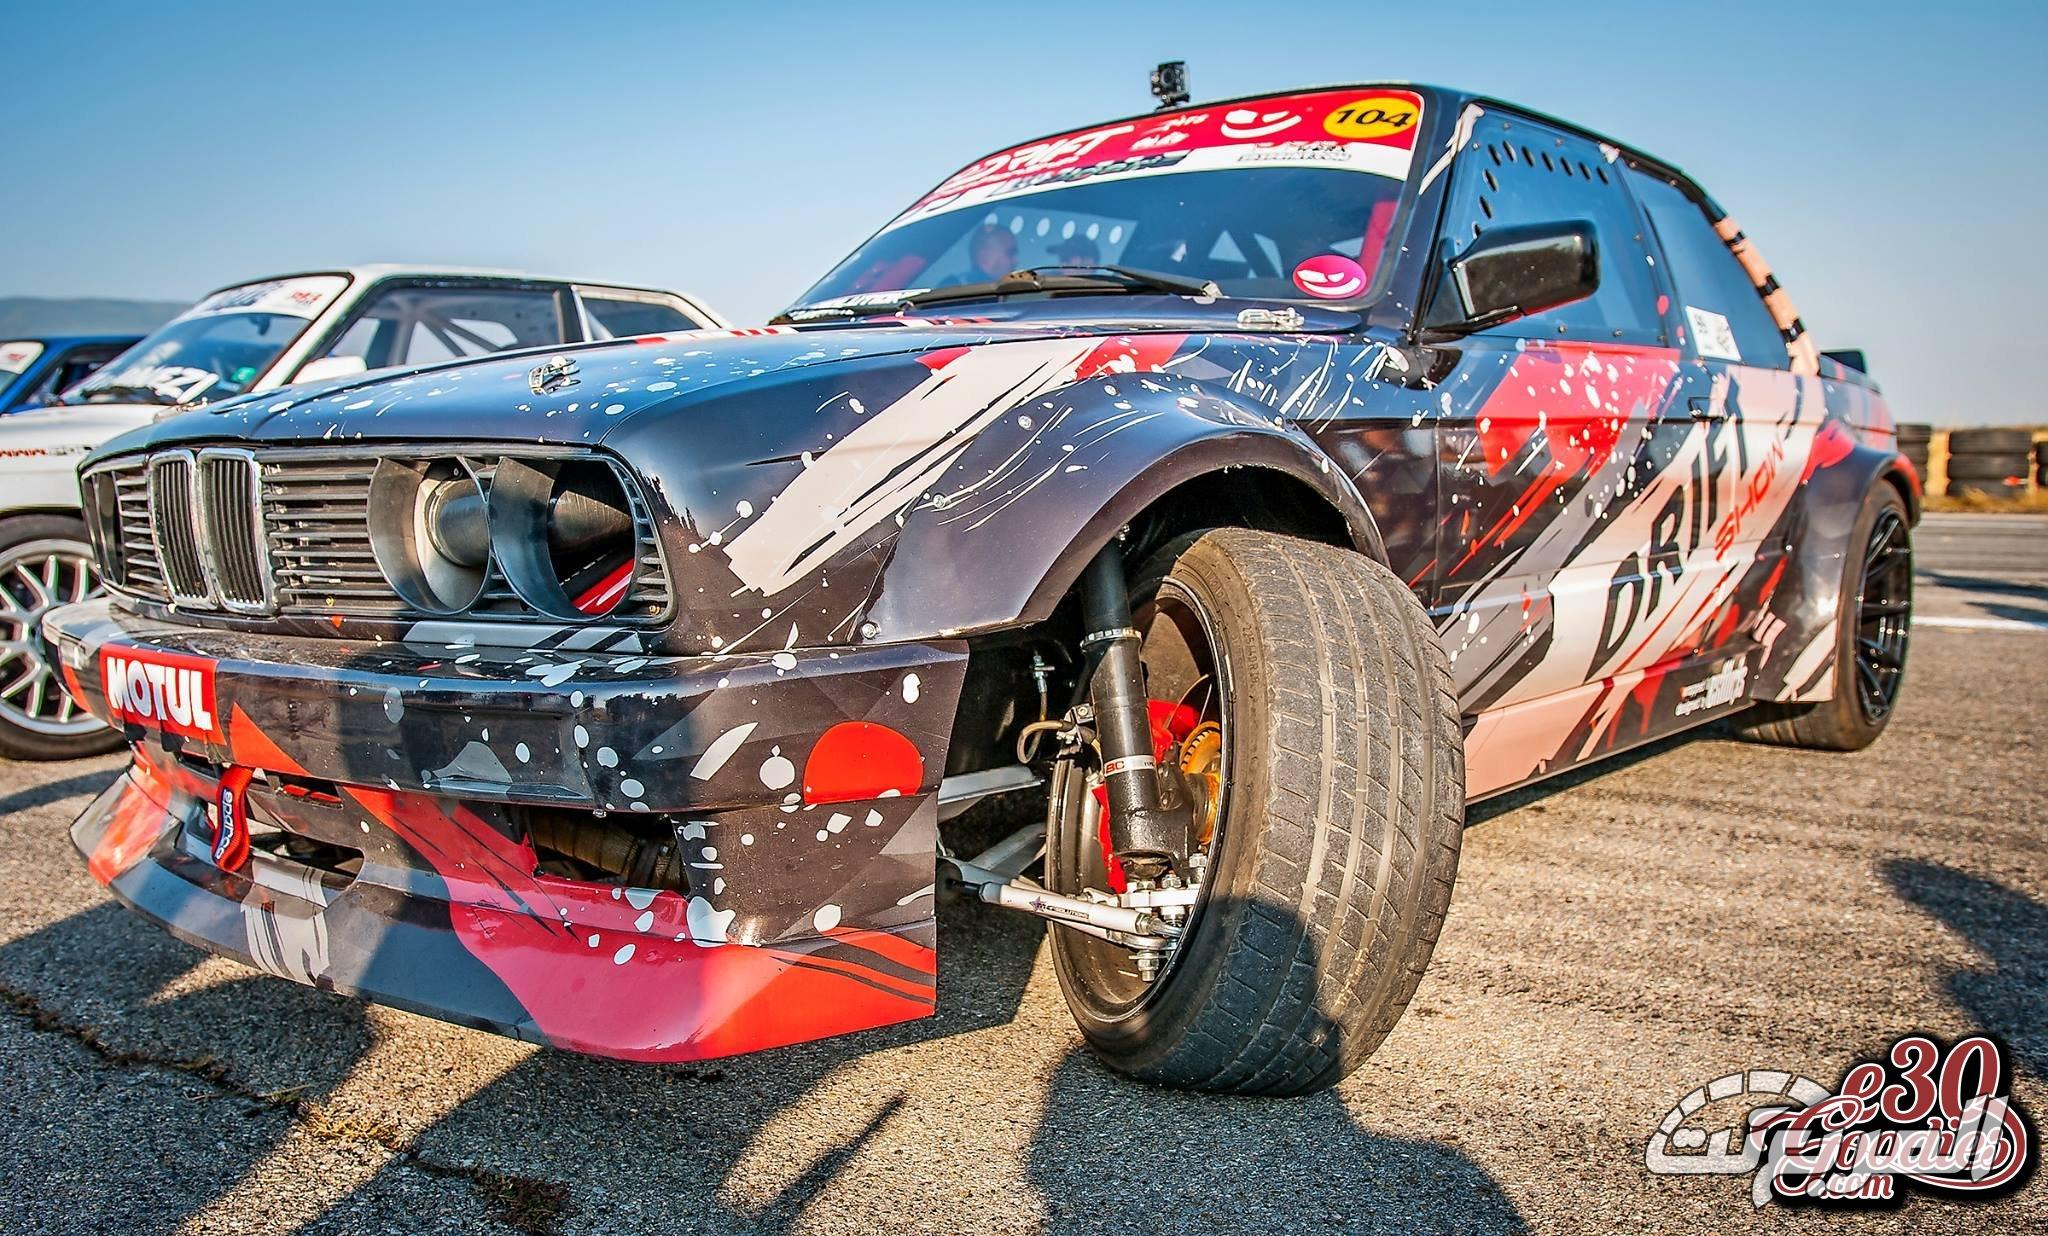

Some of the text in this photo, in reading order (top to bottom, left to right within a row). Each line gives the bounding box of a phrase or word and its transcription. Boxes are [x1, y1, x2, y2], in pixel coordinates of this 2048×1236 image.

[1337, 109, 1412, 127] 104
[1583, 372, 1748, 682] DRIFT
[1714, 434, 1784, 562] SHOW
[107, 656, 213, 731] MOTUL
[1106, 760, 1125, 774] BC
[214, 788, 234, 860] sparco
